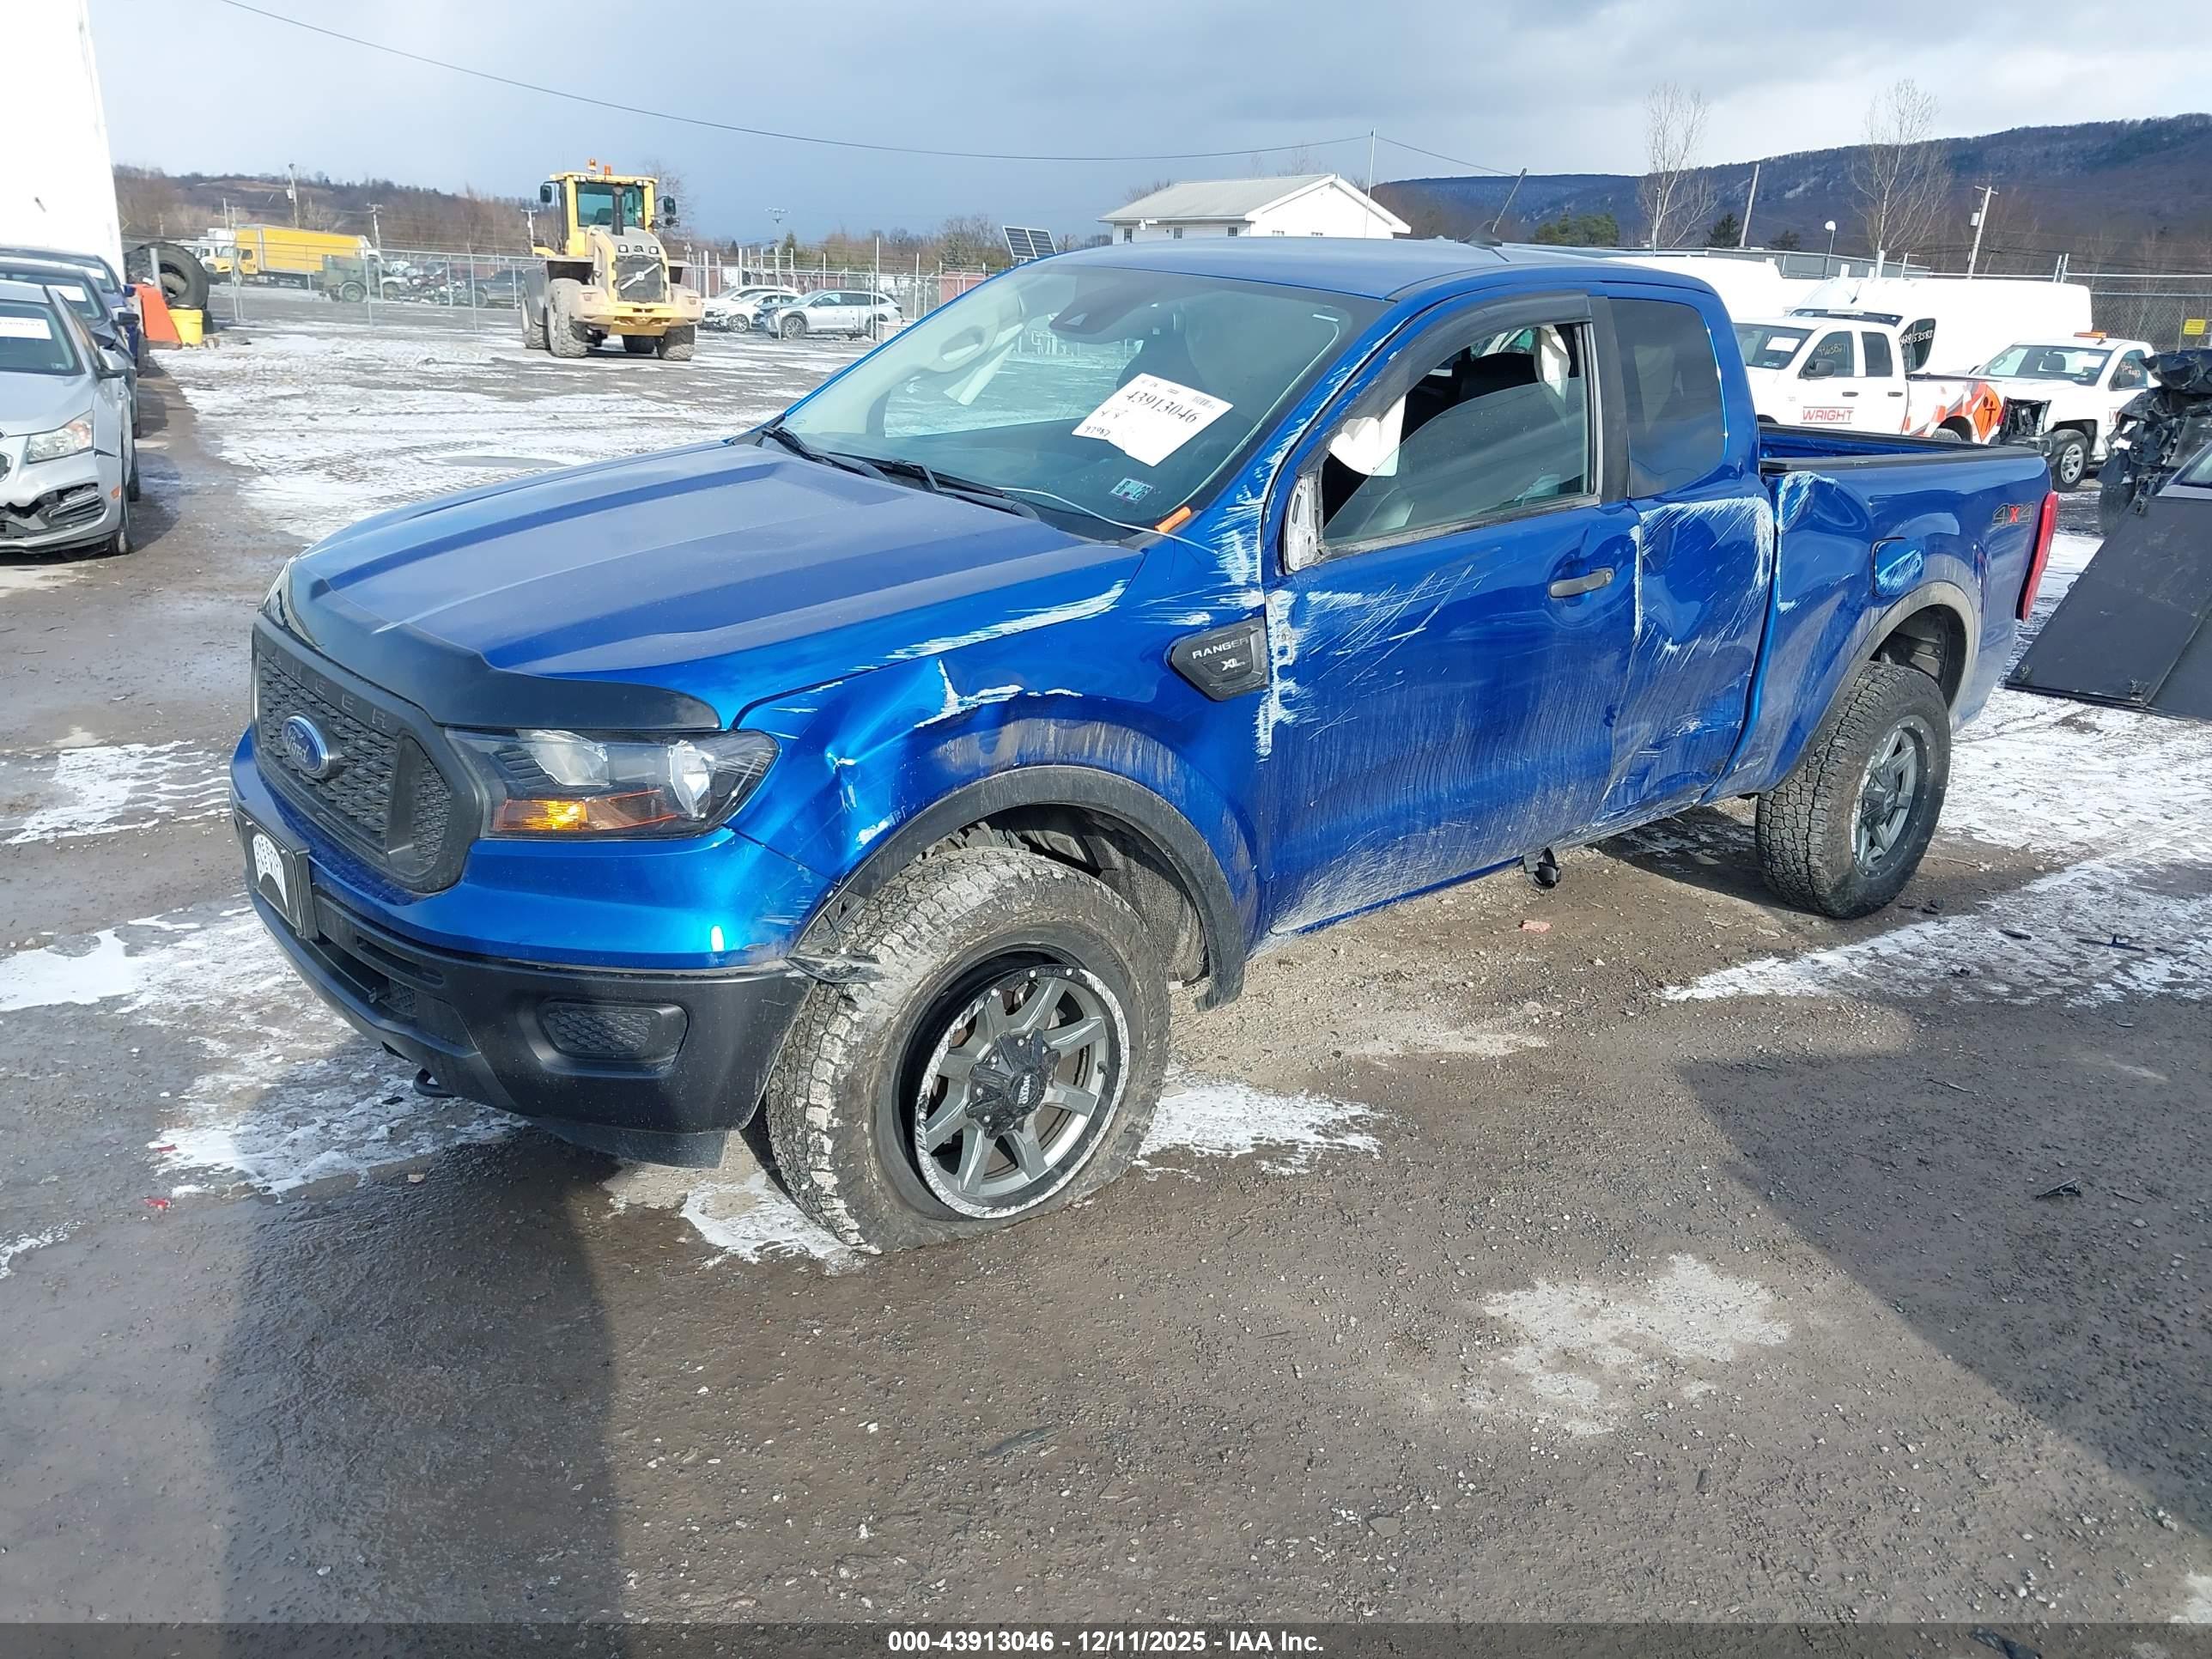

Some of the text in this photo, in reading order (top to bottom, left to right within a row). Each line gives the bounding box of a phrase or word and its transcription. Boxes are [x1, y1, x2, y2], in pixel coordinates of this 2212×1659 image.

[1127, 391, 1201, 423] 43913046
[1803, 409, 1854, 421] WRIGHT
[1192, 637, 1249, 659] RANGER
[1221, 658, 1245, 672] XL
[287, 725, 310, 763] Ford
